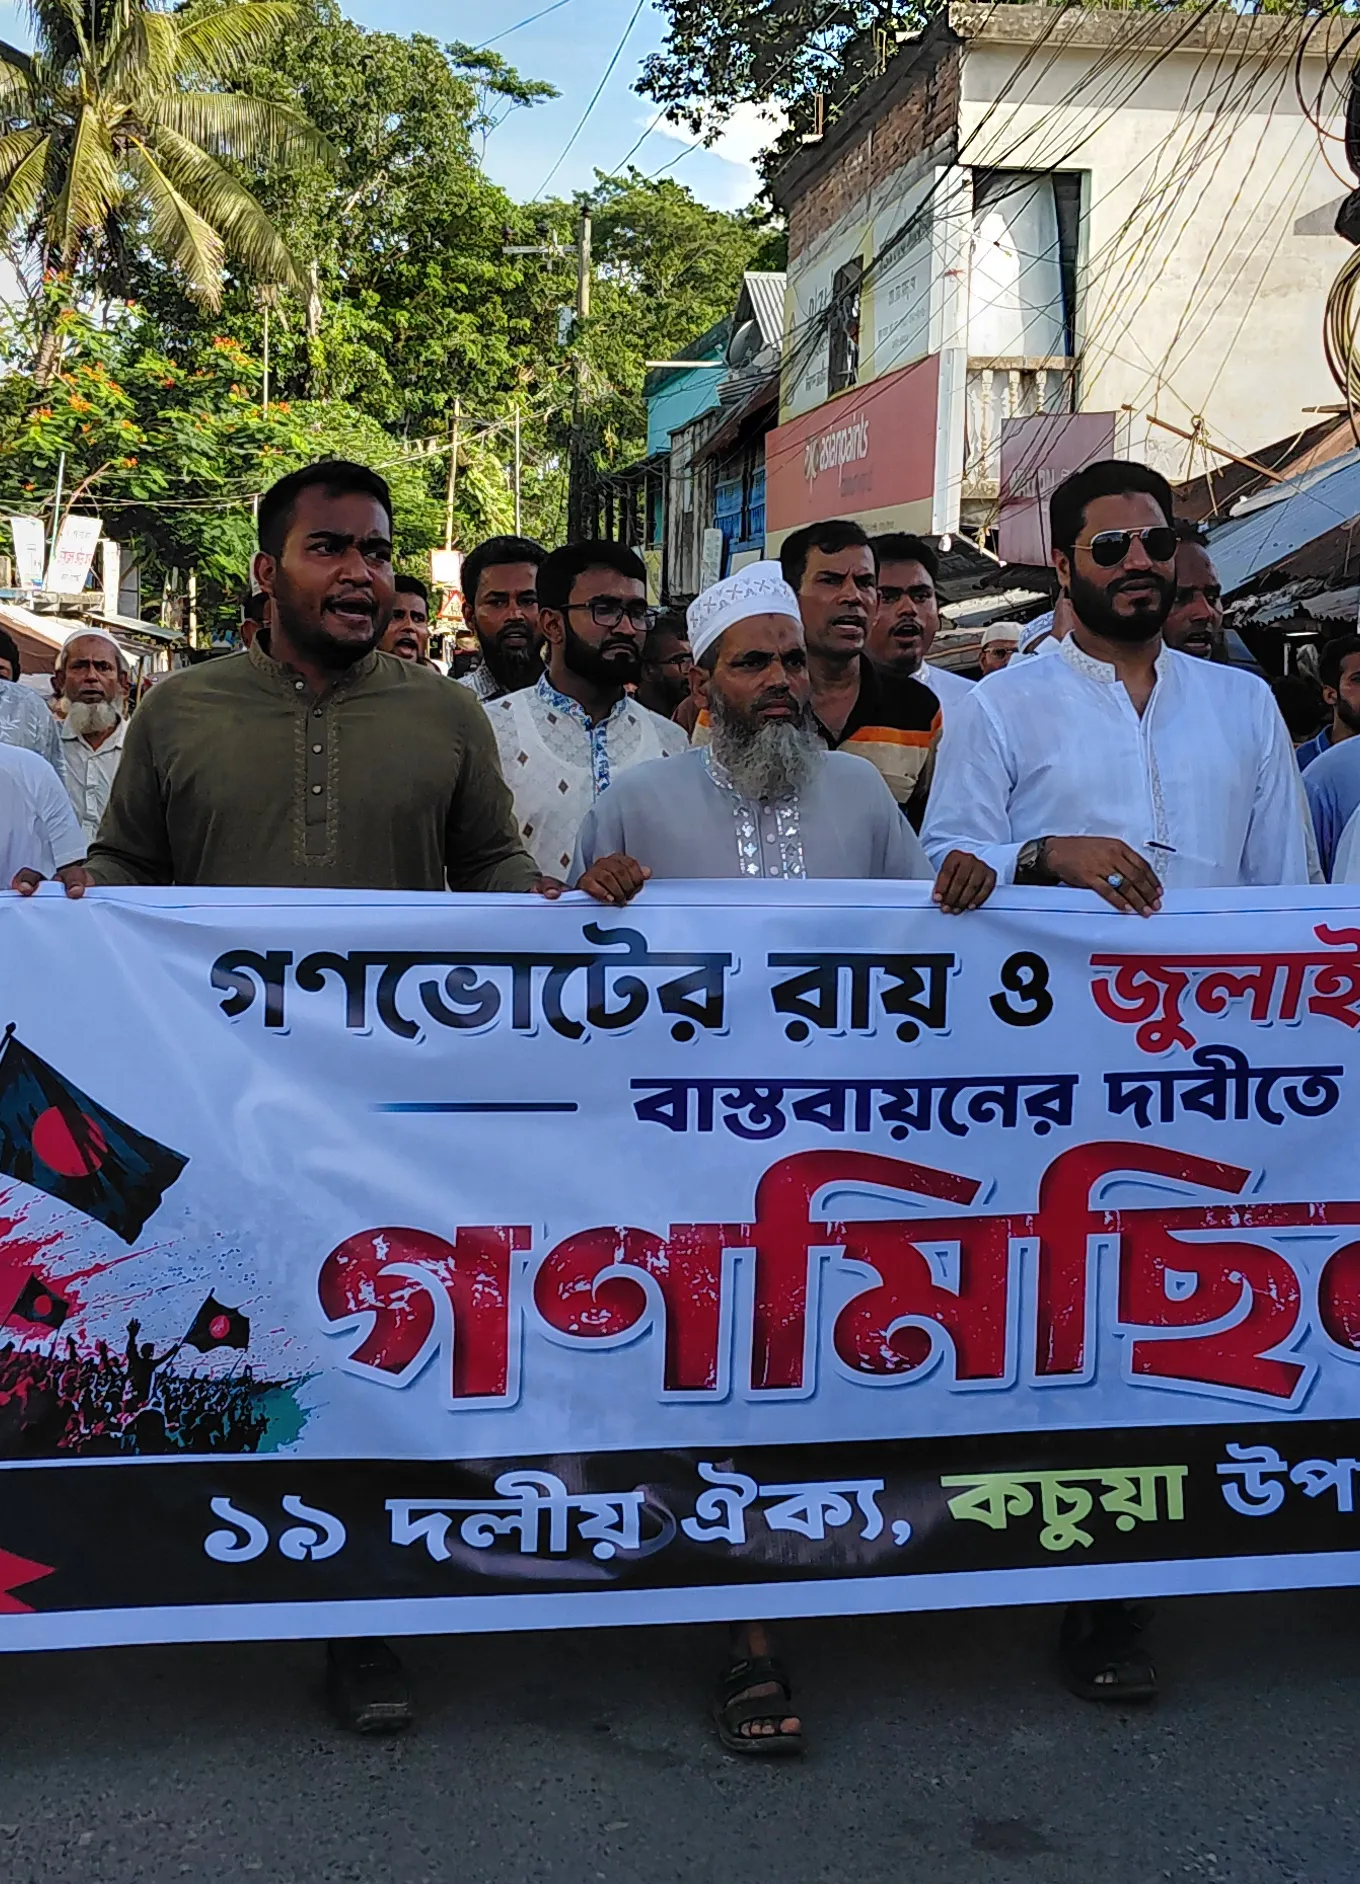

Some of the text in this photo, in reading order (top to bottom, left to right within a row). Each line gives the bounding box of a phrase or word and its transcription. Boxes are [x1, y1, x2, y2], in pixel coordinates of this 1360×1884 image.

[211, 923, 733, 1043] গণভোটের
[771, 950, 956, 1043] রায়
[990, 950, 1054, 1028] ও
[631, 1045, 1344, 1140] বাস্তবায়নের দাবীতে
[204, 1495, 348, 1563] ১৯
[387, 1470, 643, 1563] দলীয়
[680, 1461, 912, 1547] ঐক্য,
[941, 1464, 1189, 1549] কচুয়া
